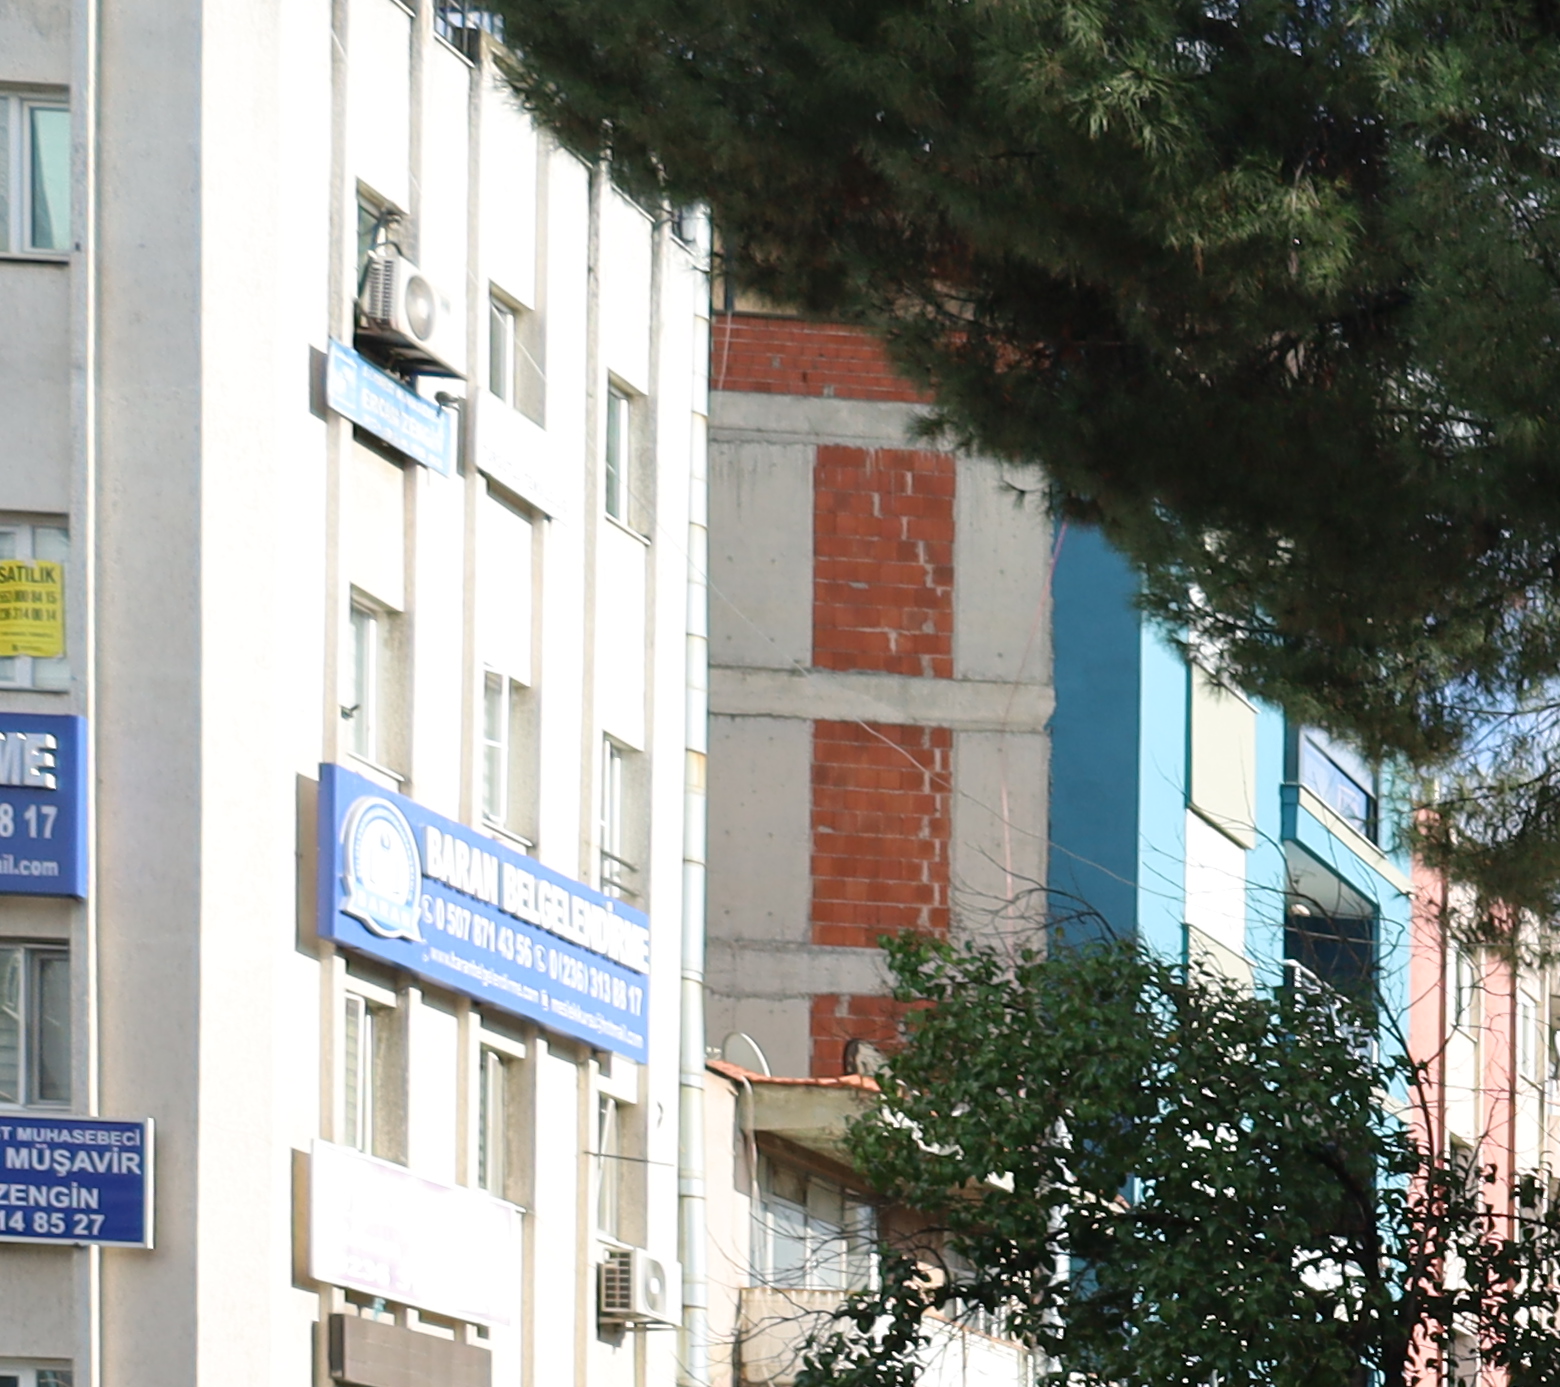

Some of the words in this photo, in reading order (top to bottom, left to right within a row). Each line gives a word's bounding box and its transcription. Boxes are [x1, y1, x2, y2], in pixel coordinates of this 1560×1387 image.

[23, 804, 58, 839] 17
[0, 854, 59, 876] il.com
[422, 825, 499, 905] BARAN
[501, 861, 650, 976] BELGELENDİRME
[628, 984, 644, 1017] 17
[16, 1126, 140, 1147] MUHASEBECİ
[5, 1143, 142, 1177] MÜŞAVİR
[0, 1181, 99, 1210] ZENGİN
[33, 1211, 66, 1234] 85
[72, 1213, 105, 1236] 27
